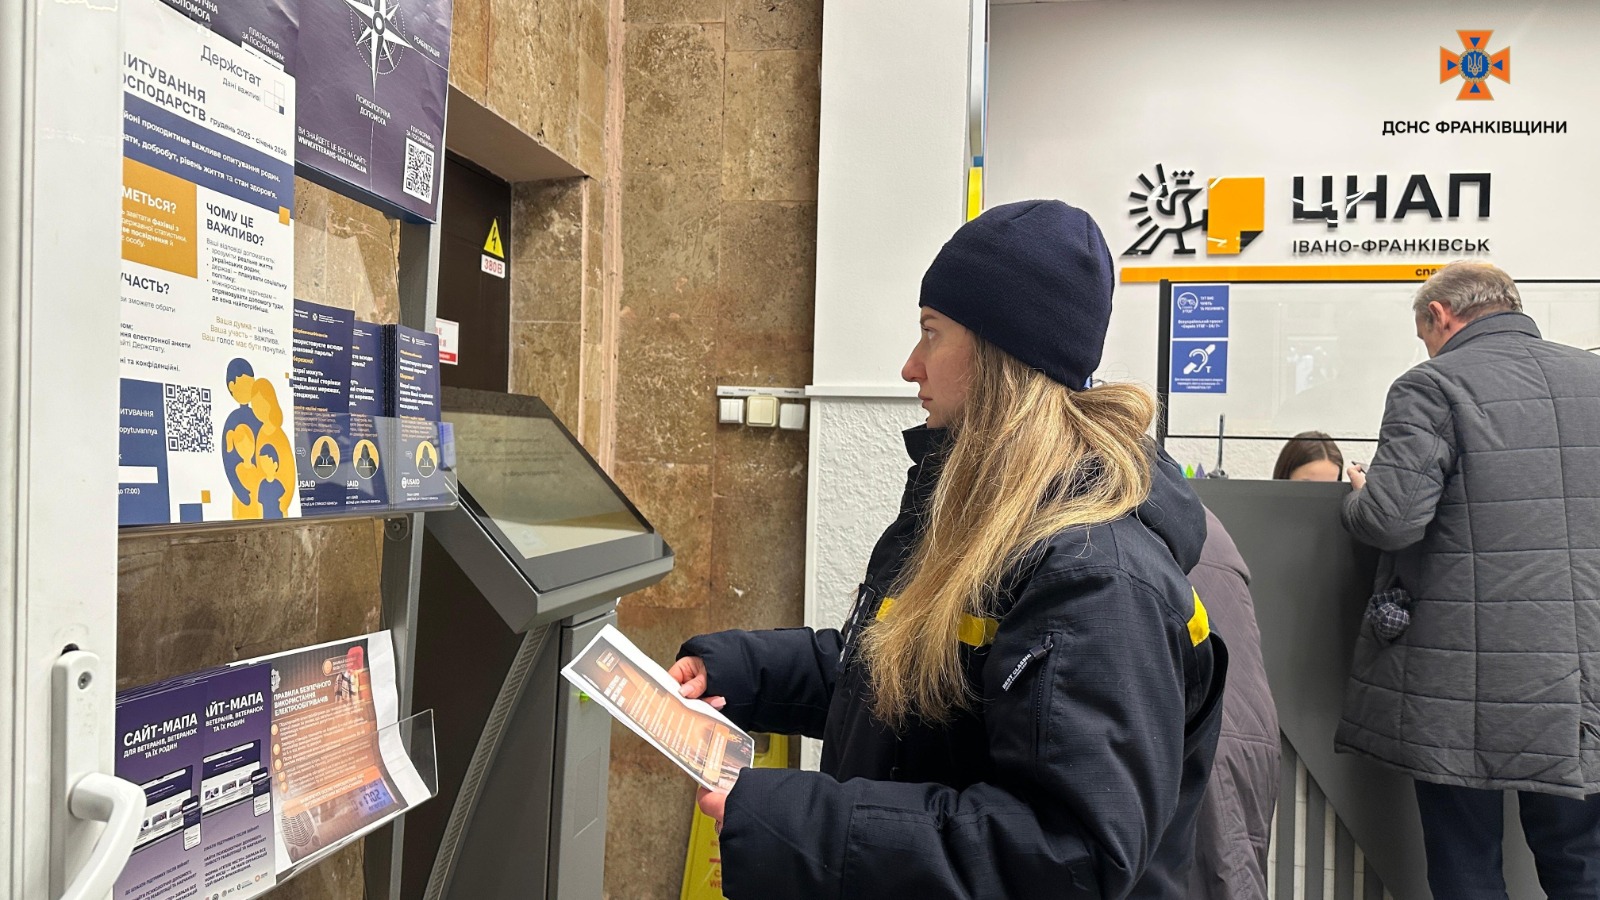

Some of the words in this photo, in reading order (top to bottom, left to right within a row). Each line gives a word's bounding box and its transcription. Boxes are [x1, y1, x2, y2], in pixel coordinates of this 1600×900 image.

[241, 31, 250, 41] ЗА
[249, 26, 280, 50] ПЛАТФОРМА
[201, 45, 261, 87] Держстат
[223, 77, 237, 91] Дані
[210, 116, 236, 136] грудень
[359, 106, 387, 127] ДОПОМОГА
[142, 120, 191, 147] проходитиме
[191, 141, 222, 160] важливе
[222, 153, 260, 176] опитування
[260, 169, 281, 183] родин.
[298, 126, 306, 134] ВИ
[306, 128, 331, 149] ЗНАЙДЕТЕ
[338, 143, 347, 156] ВСЕ
[347, 148, 354, 159] НА
[142, 141, 180, 163] добробут,
[179, 155, 203, 172] рівень
[203, 166, 226, 181] життя
[226, 173, 235, 184] та
[234, 176, 249, 190] стан
[1292, 173, 1492, 229] ЦНАП
[206, 202, 238, 223] ЧОМУ
[240, 213, 255, 229] ЦЕ
[206, 218, 264, 246] ВАЖЛИВО?
[1292, 238, 1491, 255] ІВАНО-ФРАНКІВСЬК
[128, 296, 155, 310] зможете
[210, 323, 227, 335] Ваша
[215, 315, 233, 327] Ваша
[201, 332, 216, 343] Ваш
[216, 335, 235, 346] голос
[273, 688, 300, 701] ПРАВИЛА
[299, 679, 332, 696] БЕЗПЕЧНОГО
[274, 691, 316, 709] ВИКОРИСТАННЯ
[235, 705, 264, 721] ВЕТЕРАНОК
[275, 695, 329, 717] ЕЛЕКТРООБІГРІВАЧІВ
[123, 713, 198, 747] САЙТ-МАПА
[213, 725, 221, 733] ТА
[220, 721, 226, 732] ЇХ
[226, 717, 246, 731] РОДИН
[123, 747, 137, 759] ДЛЯ
[136, 737, 167, 755] ВЕТЕРАНІВ,
[167, 727, 199, 744] ВЕТЕРАНОК
[144, 751, 153, 760] ТА
[152, 747, 160, 758] ЇХ
[159, 743, 178, 757] РОДИН
